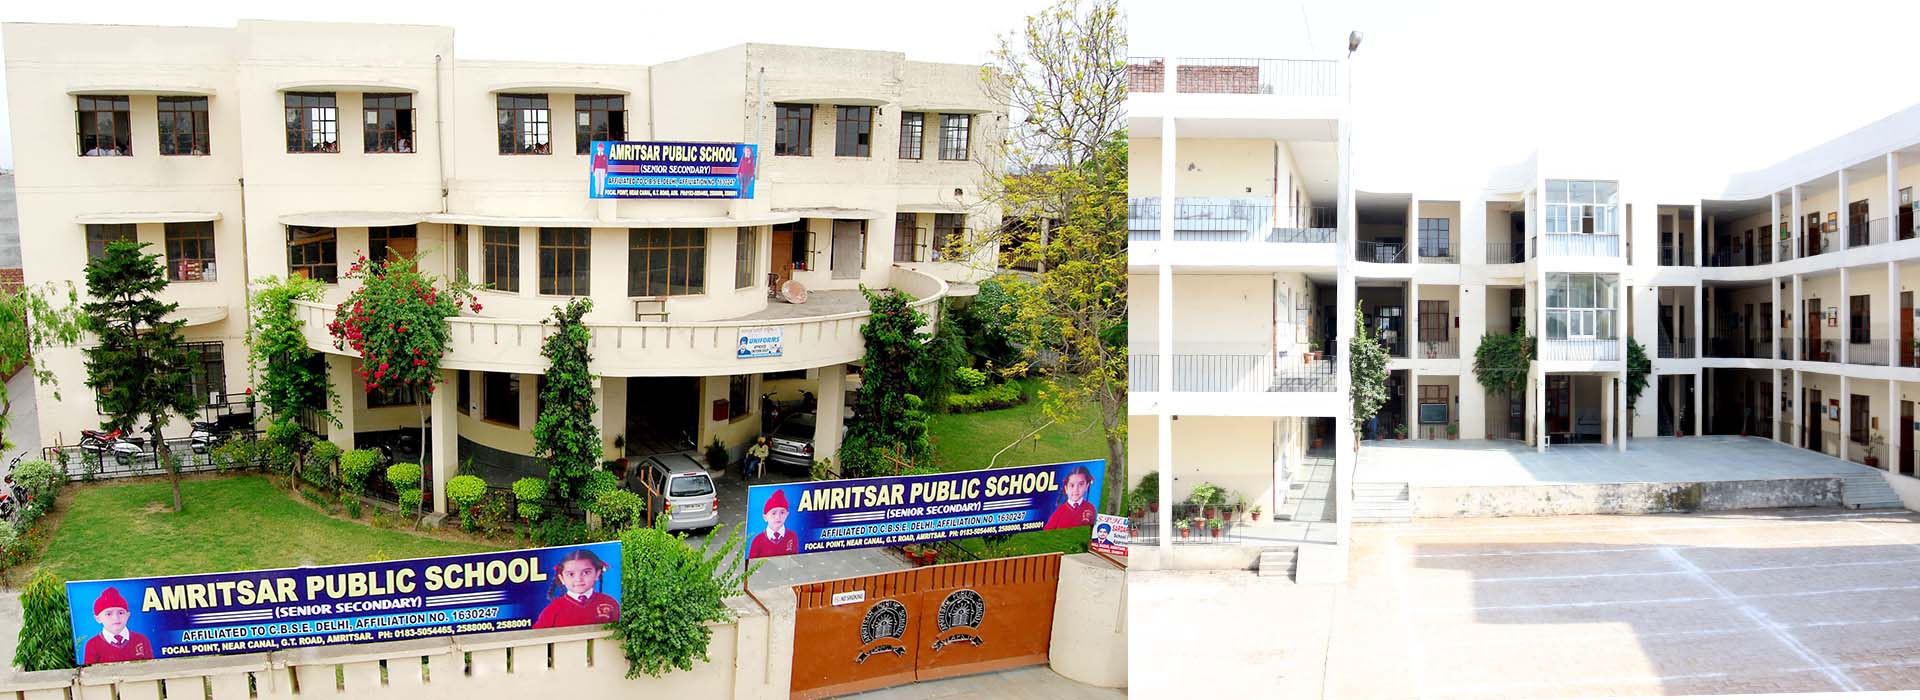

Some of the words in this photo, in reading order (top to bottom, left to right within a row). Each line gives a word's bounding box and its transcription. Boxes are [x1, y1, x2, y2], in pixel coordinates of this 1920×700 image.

[609, 144, 661, 161] AMRITSAR
[663, 145, 698, 162] PUBLIC
[700, 146, 738, 162] SCHOOL
[640, 165, 668, 174] (SENIOR
[668, 166, 711, 175] SECONDARY)
[798, 484, 905, 512] AMRITSAR
[910, 478, 980, 504] PUBLIC
[984, 471, 1059, 498] SCHOOL
[886, 507, 924, 519] (SENIOR
[926, 502, 982, 516] SECONDARY)
[820, 525, 866, 538] AFFILIATED
[868, 526, 878, 534] TO
[880, 522, 909, 533] C.B.S.E.
[910, 521, 934, 530] DELHI,
[936, 516, 981, 528] AFFILIATION
[998, 512, 1026, 522] 1630247
[804, 542, 824, 551] FOCAL
[826, 540, 846, 548] POINT,
[846, 538, 862, 547] NEAR
[864, 537, 884, 546] CANAL,
[898, 534, 916, 542] ROAD,
[916, 530, 946, 540] AMRITSAR.
[142, 577, 298, 612] AMRITSAR
[306, 568, 416, 600] PUBLIC
[424, 557, 548, 591] SCHOOL
[276, 604, 332, 619] (SENIOR
[335, 596, 422, 614] SECONDARY)
[162, 644, 191, 656] FOCAL
[192, 642, 221, 653] POINT,
[222, 640, 246, 652] NEAR
[248, 639, 280, 650] CANAL,
[281, 638, 298, 647] G.T.
[299, 636, 326, 646] ROAD,
[326, 632, 374, 644] AMRITSAR.
[378, 630, 393, 640] PH:
[456, 622, 496, 634] 2588000,
[496, 618, 532, 630] 2588001
[182, 626, 247, 642] AFFILIATED
[250, 625, 266, 636] TO
[269, 622, 312, 635] C.B.S.E.
[316, 619, 352, 632] DELHI,
[356, 614, 426, 629] AFFILIATION
[429, 612, 449, 622] NO.
[452, 608, 498, 621] 1630247
